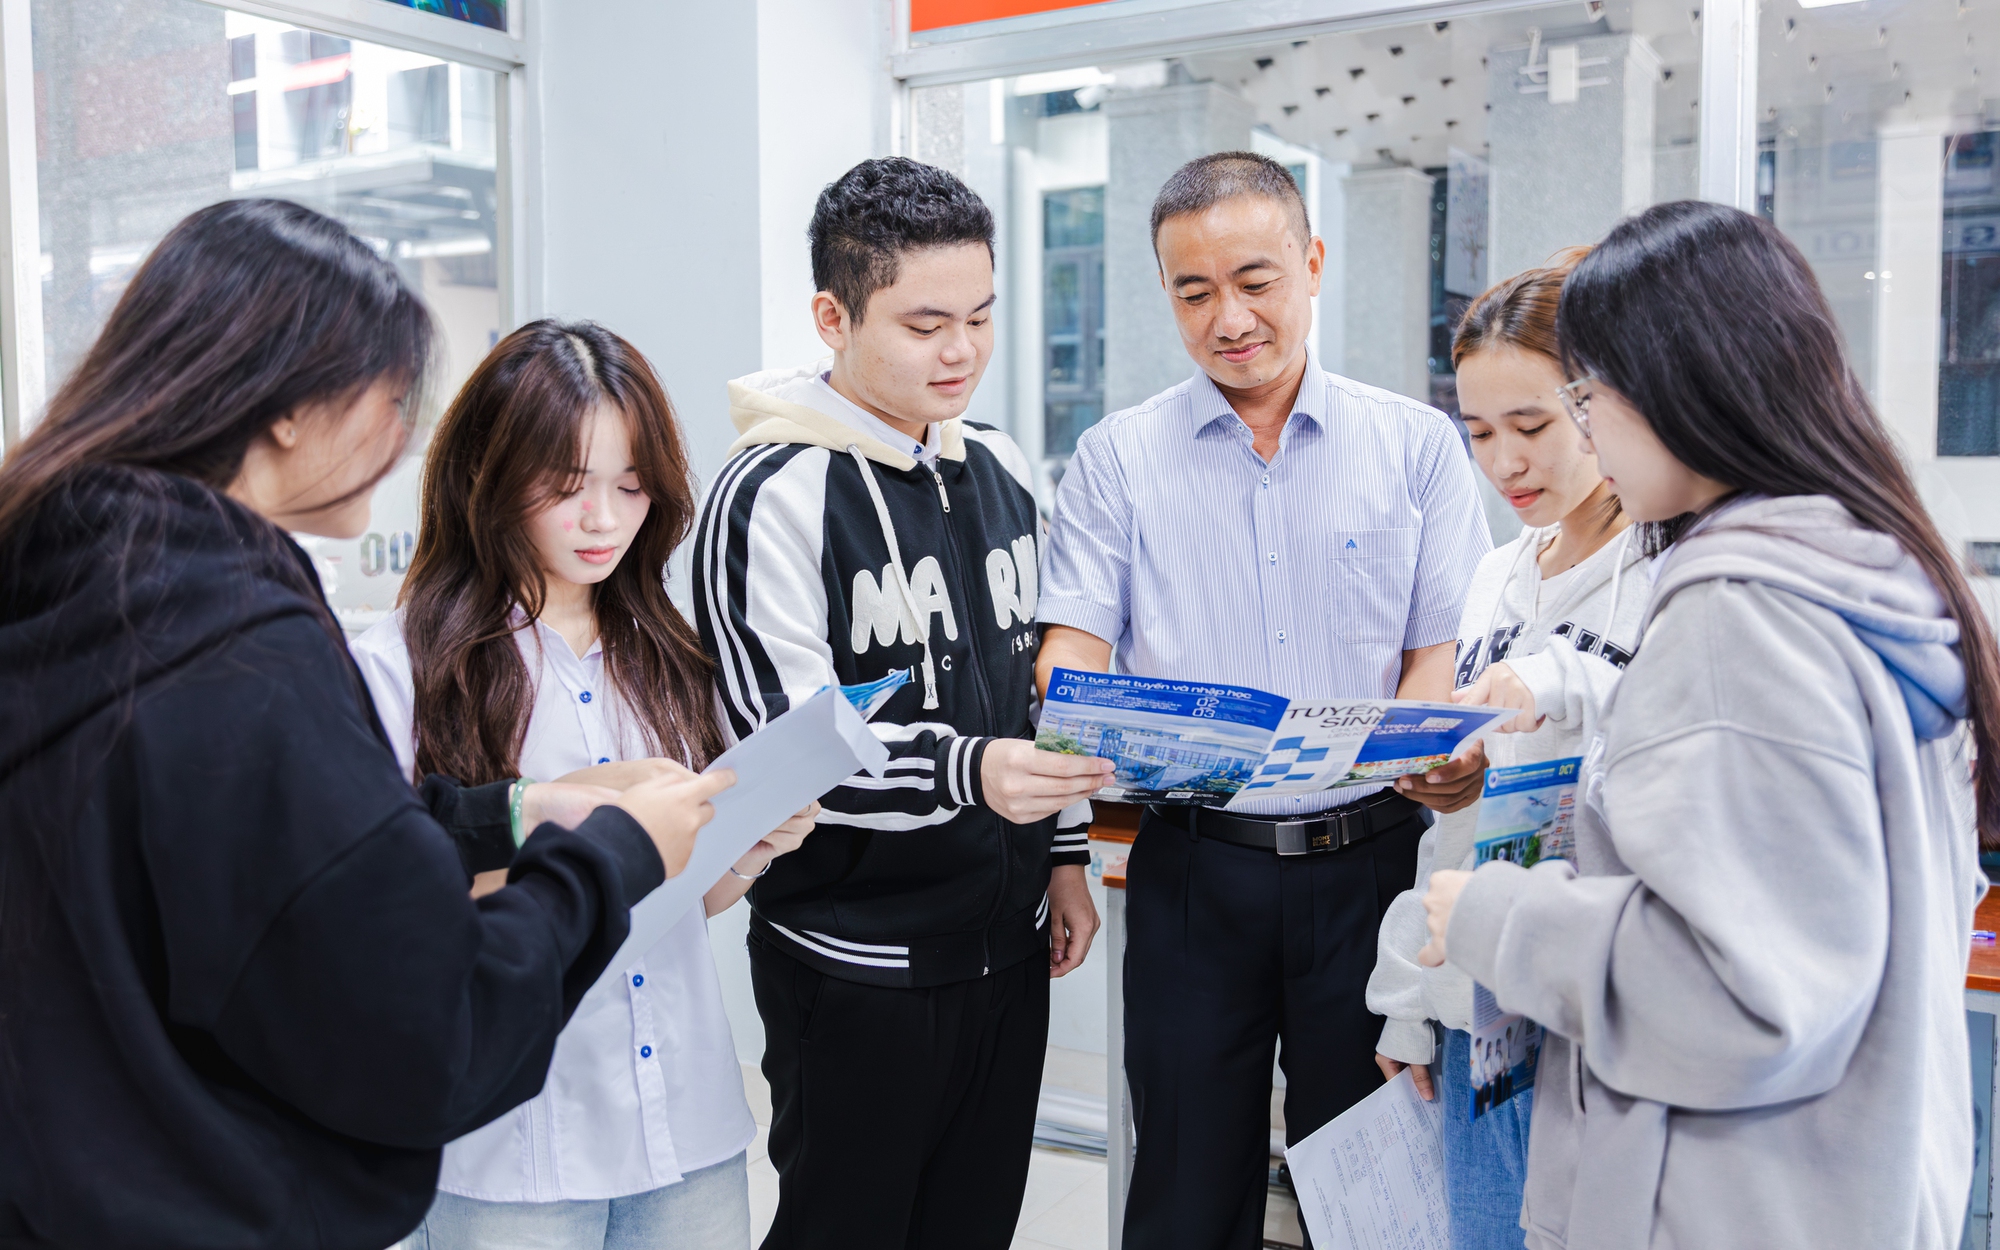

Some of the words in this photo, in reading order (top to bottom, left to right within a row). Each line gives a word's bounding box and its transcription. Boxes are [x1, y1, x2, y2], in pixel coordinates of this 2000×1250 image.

[1056, 685, 1076, 698] 01
[1062, 672, 1086, 682] Thủ
[1088, 676, 1109, 686] tục
[1172, 684, 1189, 692] và
[1191, 686, 1226, 698] nhập
[1226, 688, 1252, 700] học
[1196, 697, 1220, 709] 02
[1192, 707, 1216, 719] 03
